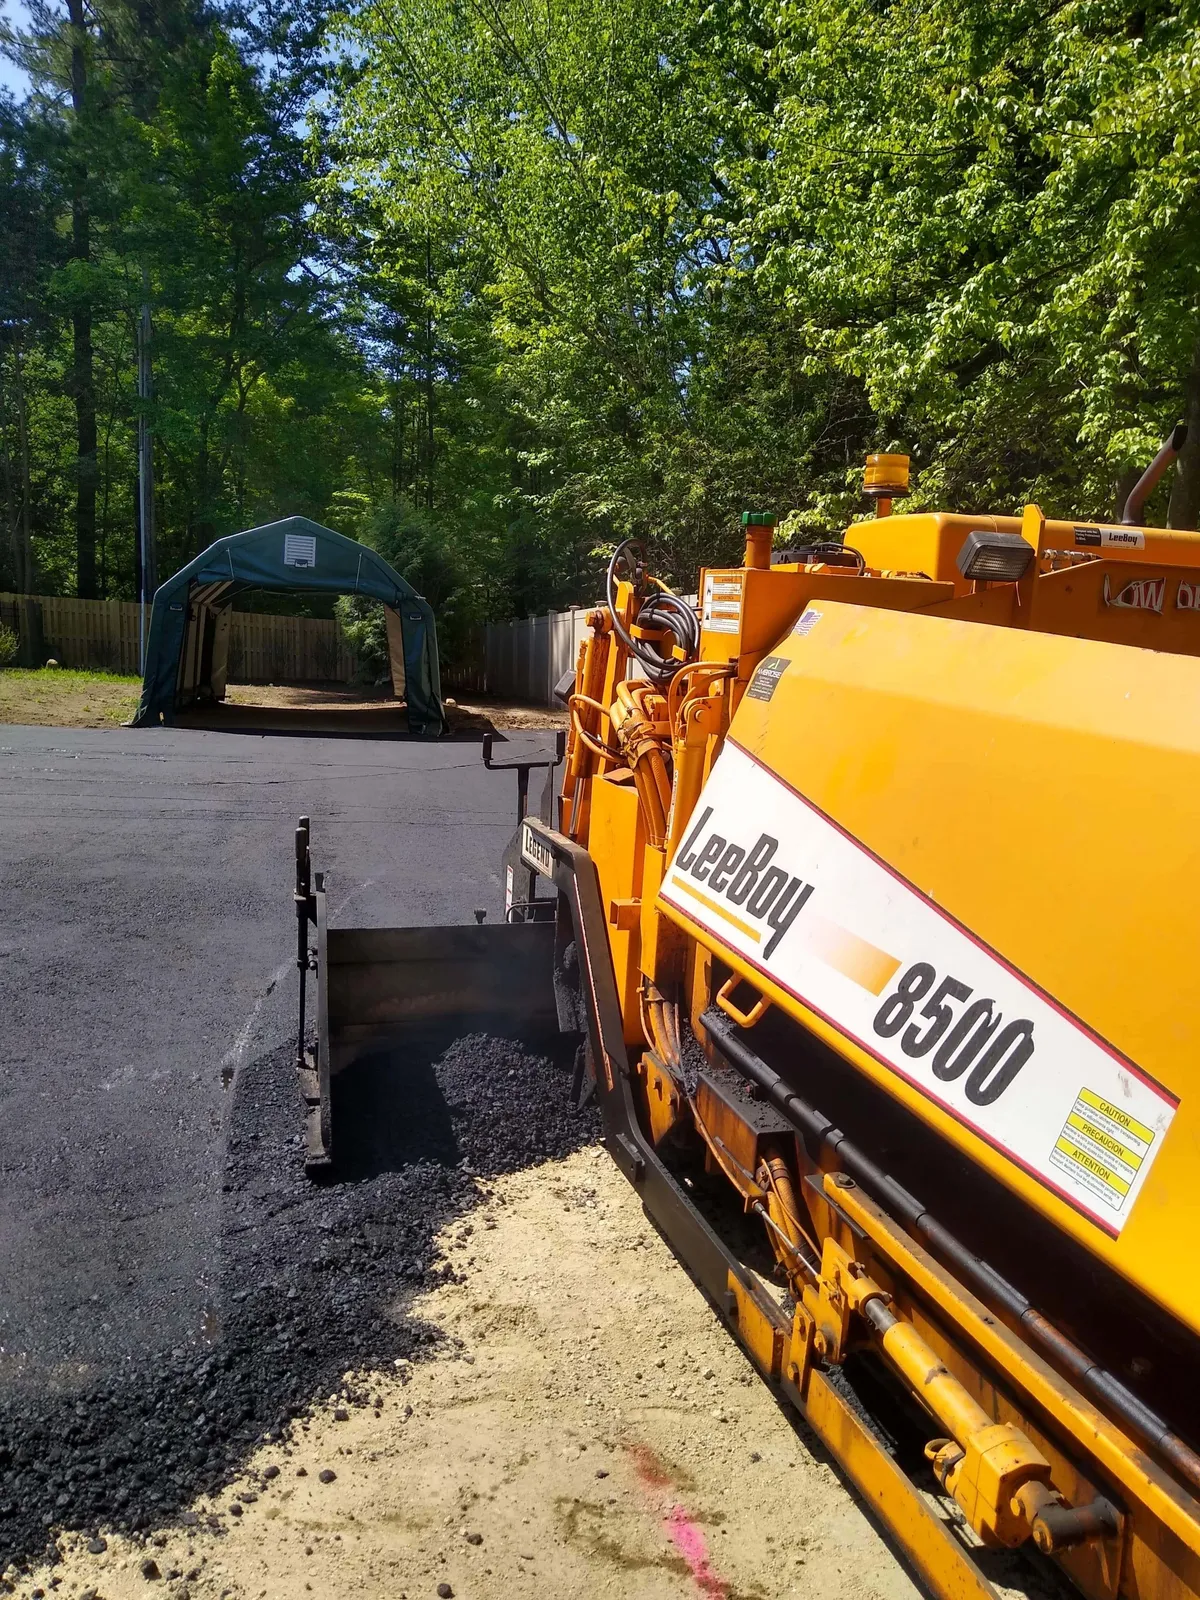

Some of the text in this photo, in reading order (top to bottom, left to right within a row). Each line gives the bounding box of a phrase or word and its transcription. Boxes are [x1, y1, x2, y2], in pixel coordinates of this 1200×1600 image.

[1108, 532, 1138, 546] LeeBoy
[525, 828, 550, 869] LEGEND
[675, 806, 815, 961] LeeBoy
[873, 962, 1035, 1106] 8500
[1099, 1102, 1130, 1126] CAUTION
[1082, 1124, 1124, 1156] PRECAUCION
[1072, 1150, 1110, 1180] ATTENTION
